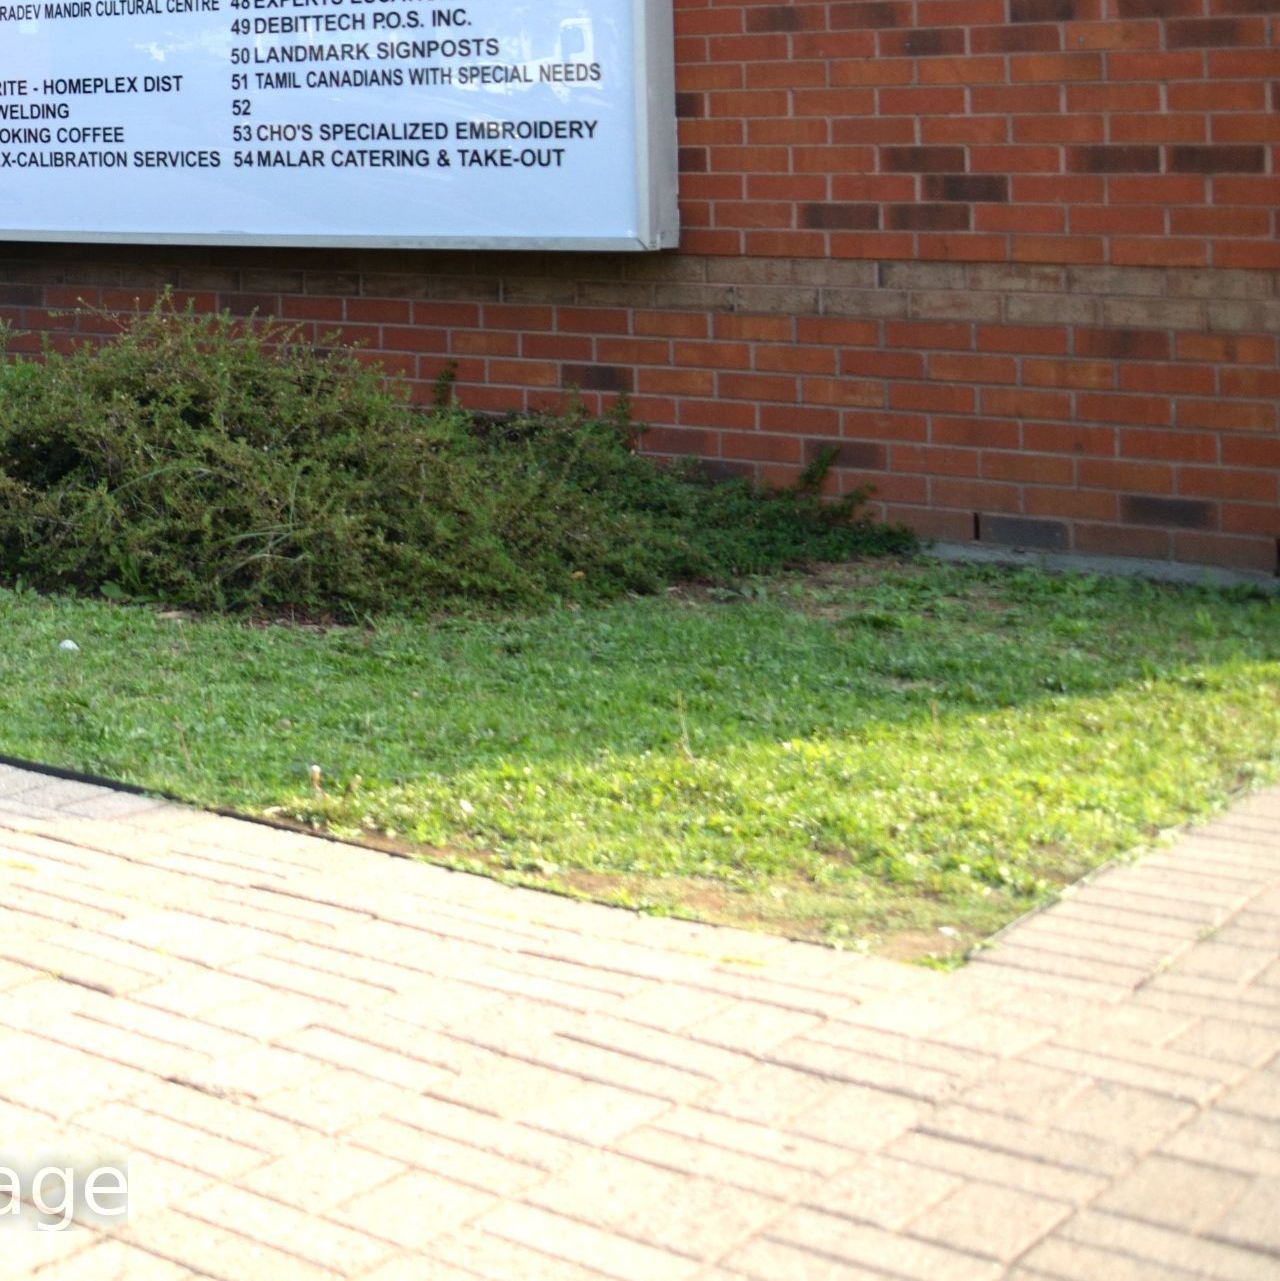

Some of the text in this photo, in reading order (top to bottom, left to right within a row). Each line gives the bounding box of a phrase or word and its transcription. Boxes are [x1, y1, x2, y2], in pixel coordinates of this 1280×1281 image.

[43, 1, 92, 19] MANDIR
[253, 13, 365, 34] DEBITTECH
[431, 8, 472, 27] INC.
[253, 38, 499, 64] LANDMARK SIGNPOSTS
[42, 76, 138, 95] HOMEPLEX
[143, 75, 183, 92] DIST
[254, 63, 601, 89] TAMIL CANADIANS WITH SPECIAL NEEDS
[231, 99, 251, 116] 52
[55, 127, 124, 143] COFFEE
[256, 120, 598, 142] CHO'S SPECIALIZED EMBROIDERY
[132, 151, 221, 168] SERVICES
[256, 148, 565, 167] MALAR CATERING & TAKE-OUT
